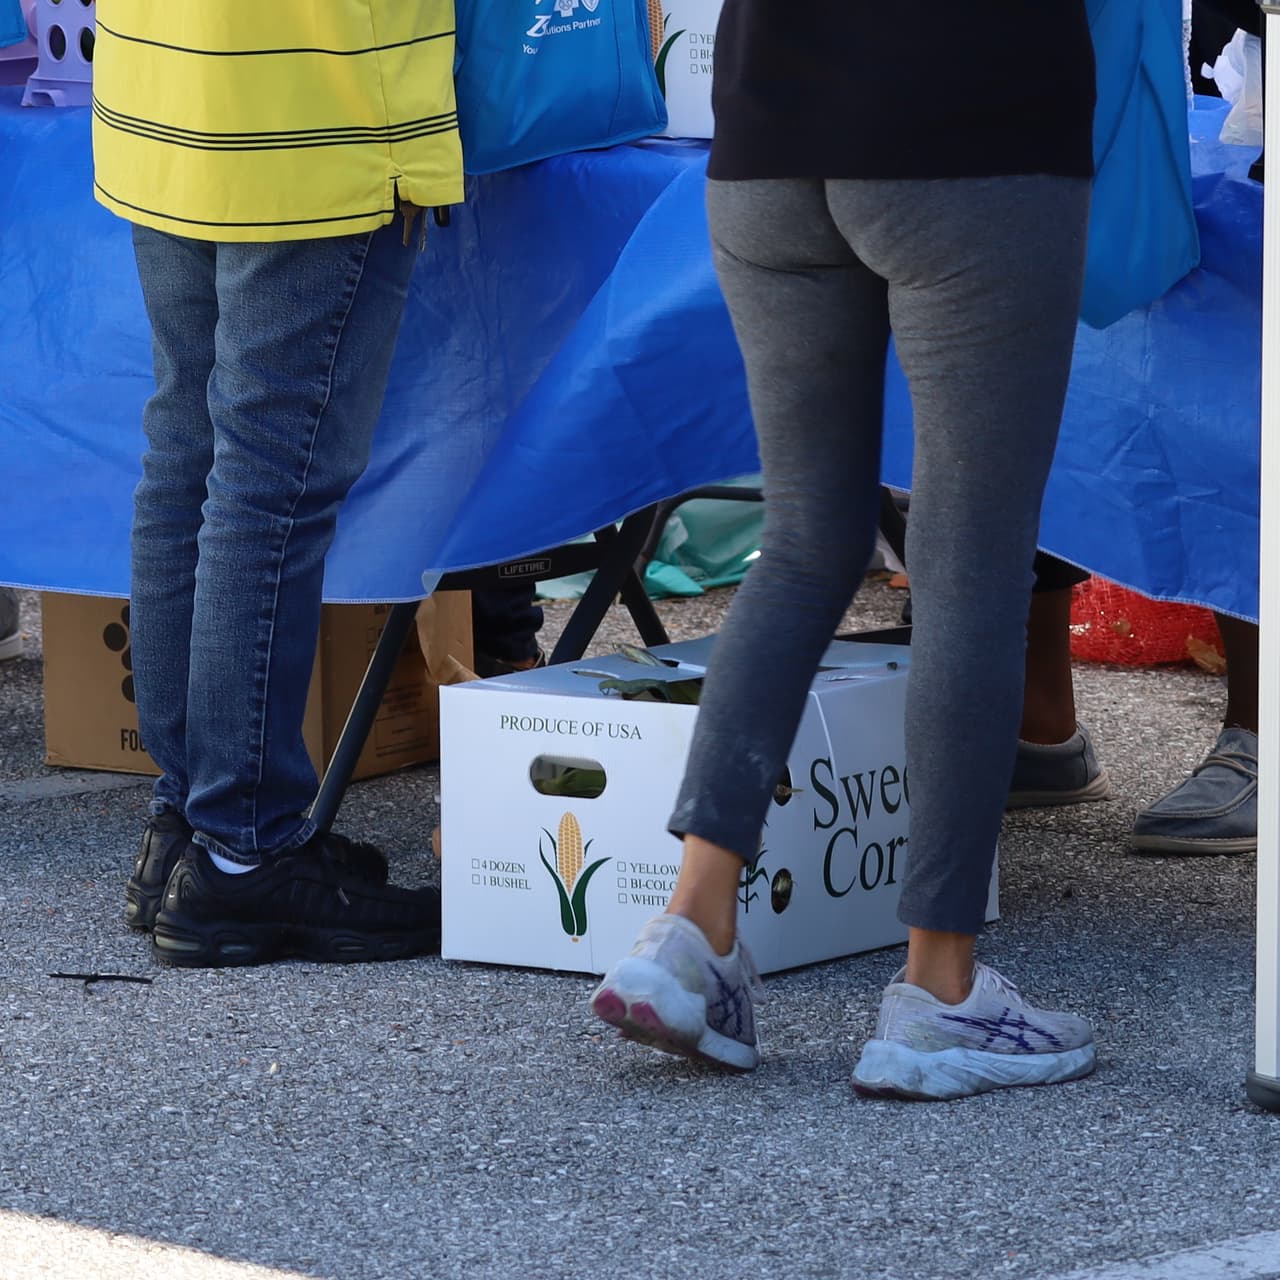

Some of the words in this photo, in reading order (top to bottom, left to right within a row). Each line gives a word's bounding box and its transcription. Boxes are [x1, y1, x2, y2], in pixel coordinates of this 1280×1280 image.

[500, 715, 578, 735] PRODUCE
[582, 722, 604, 737] OF
[608, 723, 643, 740] USA
[481, 862, 487, 870] 4
[489, 862, 526, 874] DOZEN
[823, 824, 909, 899] Cor
[630, 862, 681, 875] YELLOW
[489, 877, 531, 890] BUSHEL
[631, 894, 669, 907] WHITE
